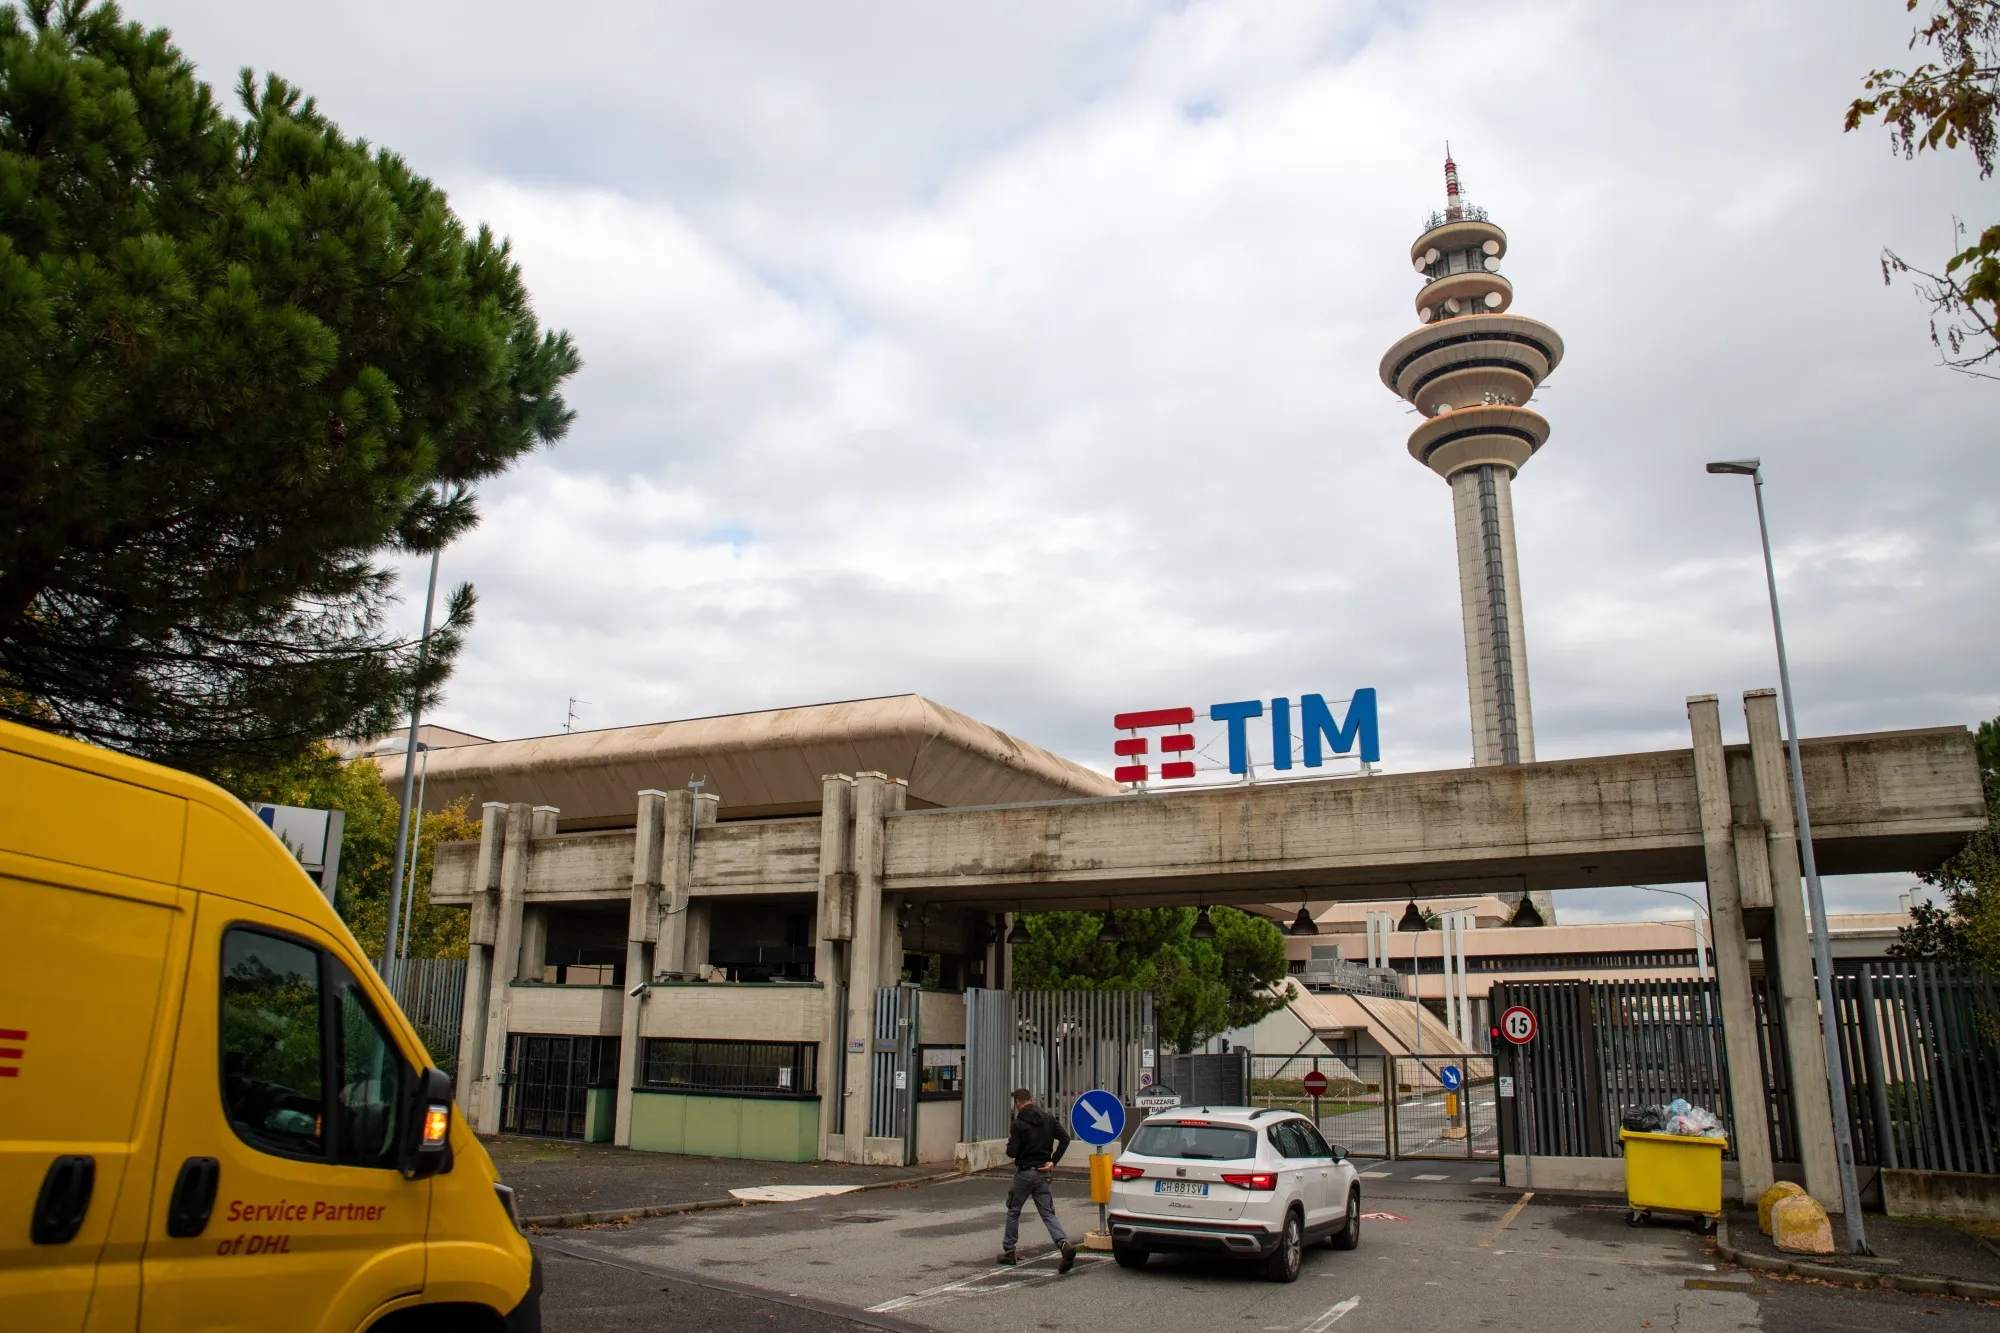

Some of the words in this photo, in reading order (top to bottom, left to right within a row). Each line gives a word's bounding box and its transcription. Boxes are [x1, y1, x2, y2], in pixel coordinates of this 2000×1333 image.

[1210, 687, 1380, 774] TIM
[1510, 1017, 1528, 1034] 15
[226, 1199, 308, 1222] Service
[312, 1201, 386, 1221] Partner
[216, 1234, 246, 1256] of
[245, 1235, 291, 1255] DHL
